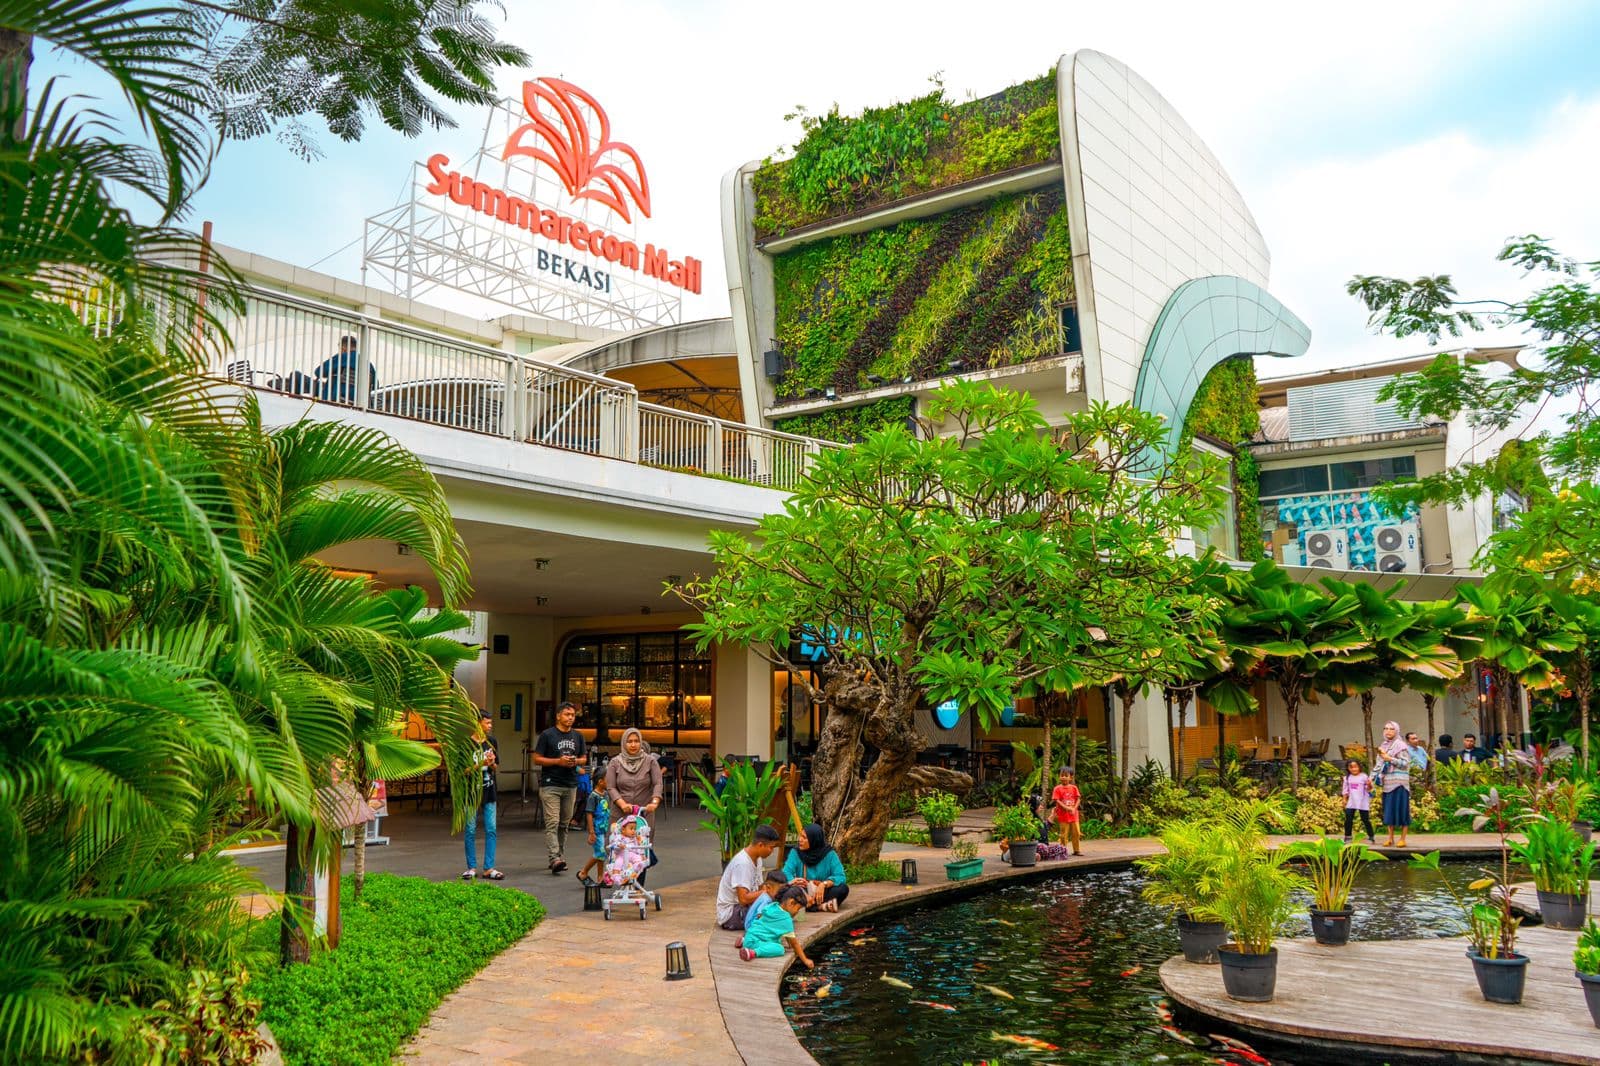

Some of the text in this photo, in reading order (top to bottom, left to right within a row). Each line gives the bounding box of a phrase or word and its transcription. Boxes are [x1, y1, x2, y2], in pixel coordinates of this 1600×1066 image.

[426, 153, 703, 295] Summarecon Mall
[536, 248, 611, 294] BEKASI
[557, 740, 576, 751] COFFEE
